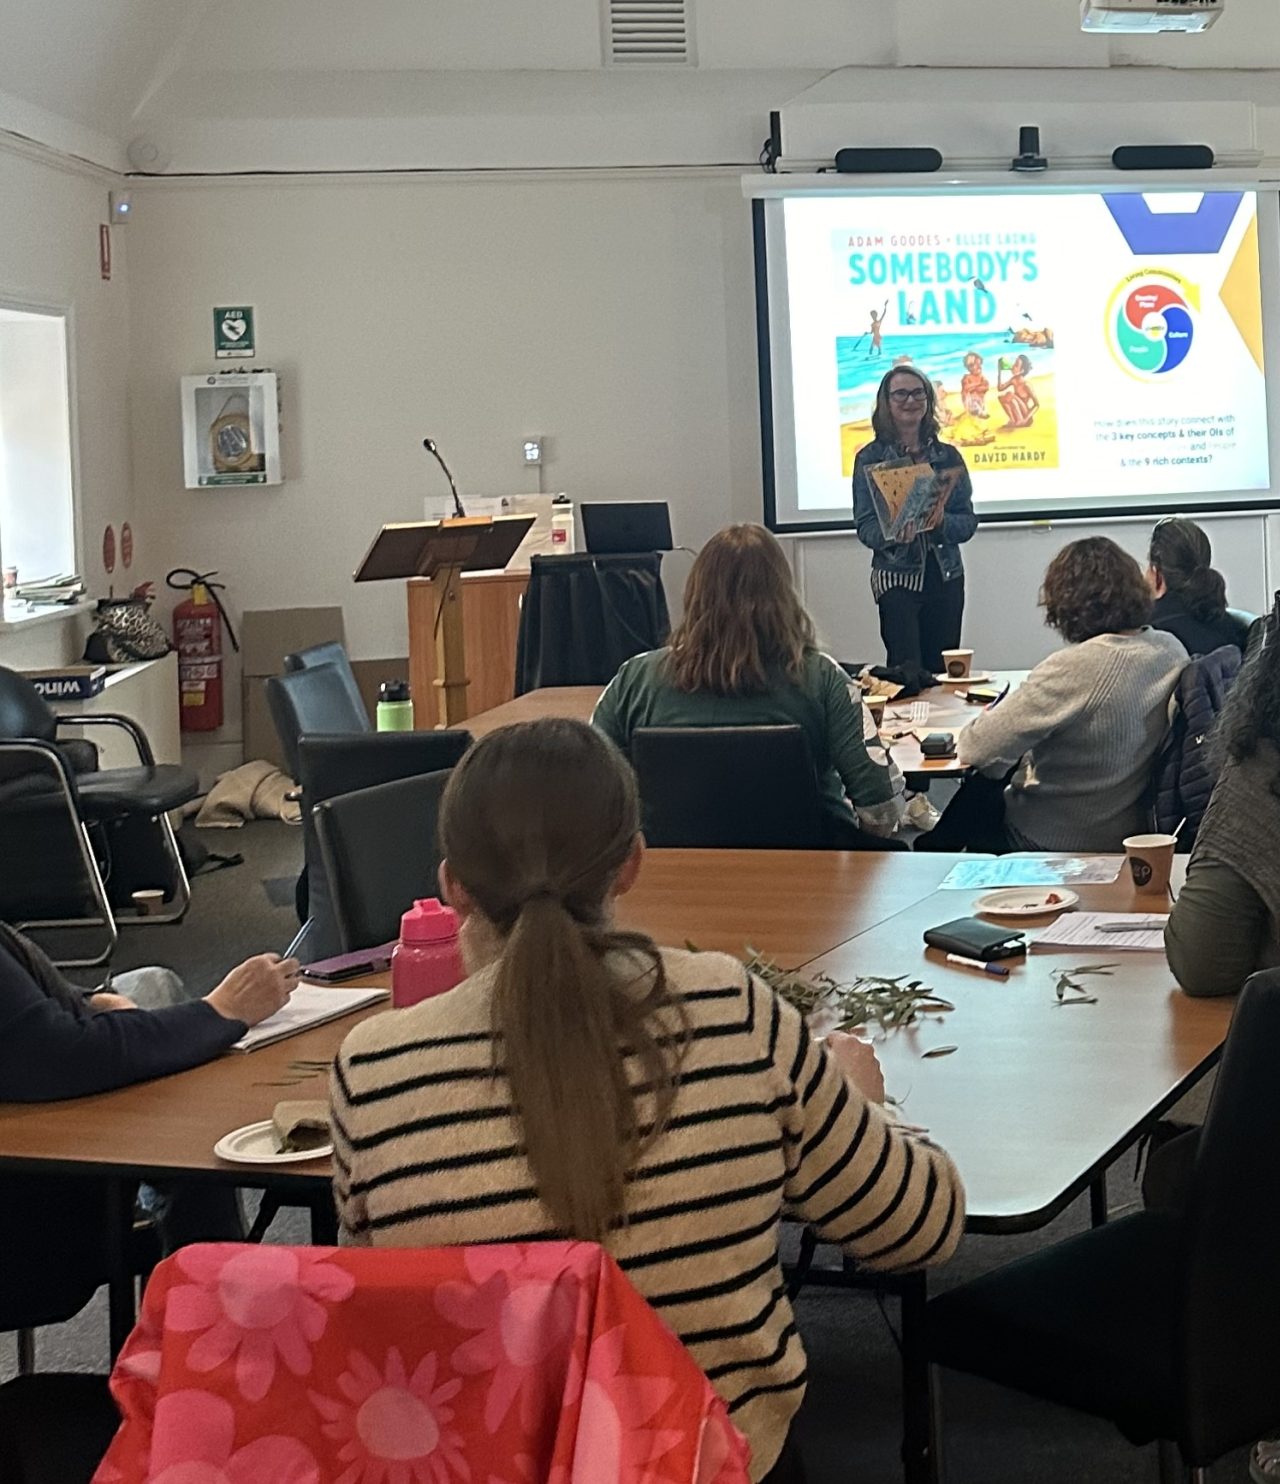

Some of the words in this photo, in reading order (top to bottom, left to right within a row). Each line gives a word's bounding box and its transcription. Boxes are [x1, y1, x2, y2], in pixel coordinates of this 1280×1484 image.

[848, 236, 884, 247] ADAM
[891, 235, 941, 246] GOODES
[955, 234, 990, 246] ELLIE
[849, 250, 1038, 285] SOMEBODY'S
[897, 288, 997, 326] LAND
[224, 311, 243, 319] AED
[1157, 416, 1178, 427] story
[1181, 415, 1215, 425] connect
[1217, 414, 1235, 423] with
[1111, 432, 1118, 441] 3
[1119, 431, 1134, 442] key
[1136, 429, 1176, 440] concepts
[1187, 427, 1207, 438] their
[1225, 427, 1235, 437] of
[1190, 441, 1207, 451] and
[974, 452, 1008, 463] DAVID
[1012, 450, 1046, 461] HARDY
[1152, 455, 1169, 466] rich
[1171, 454, 1213, 465] contexts?
